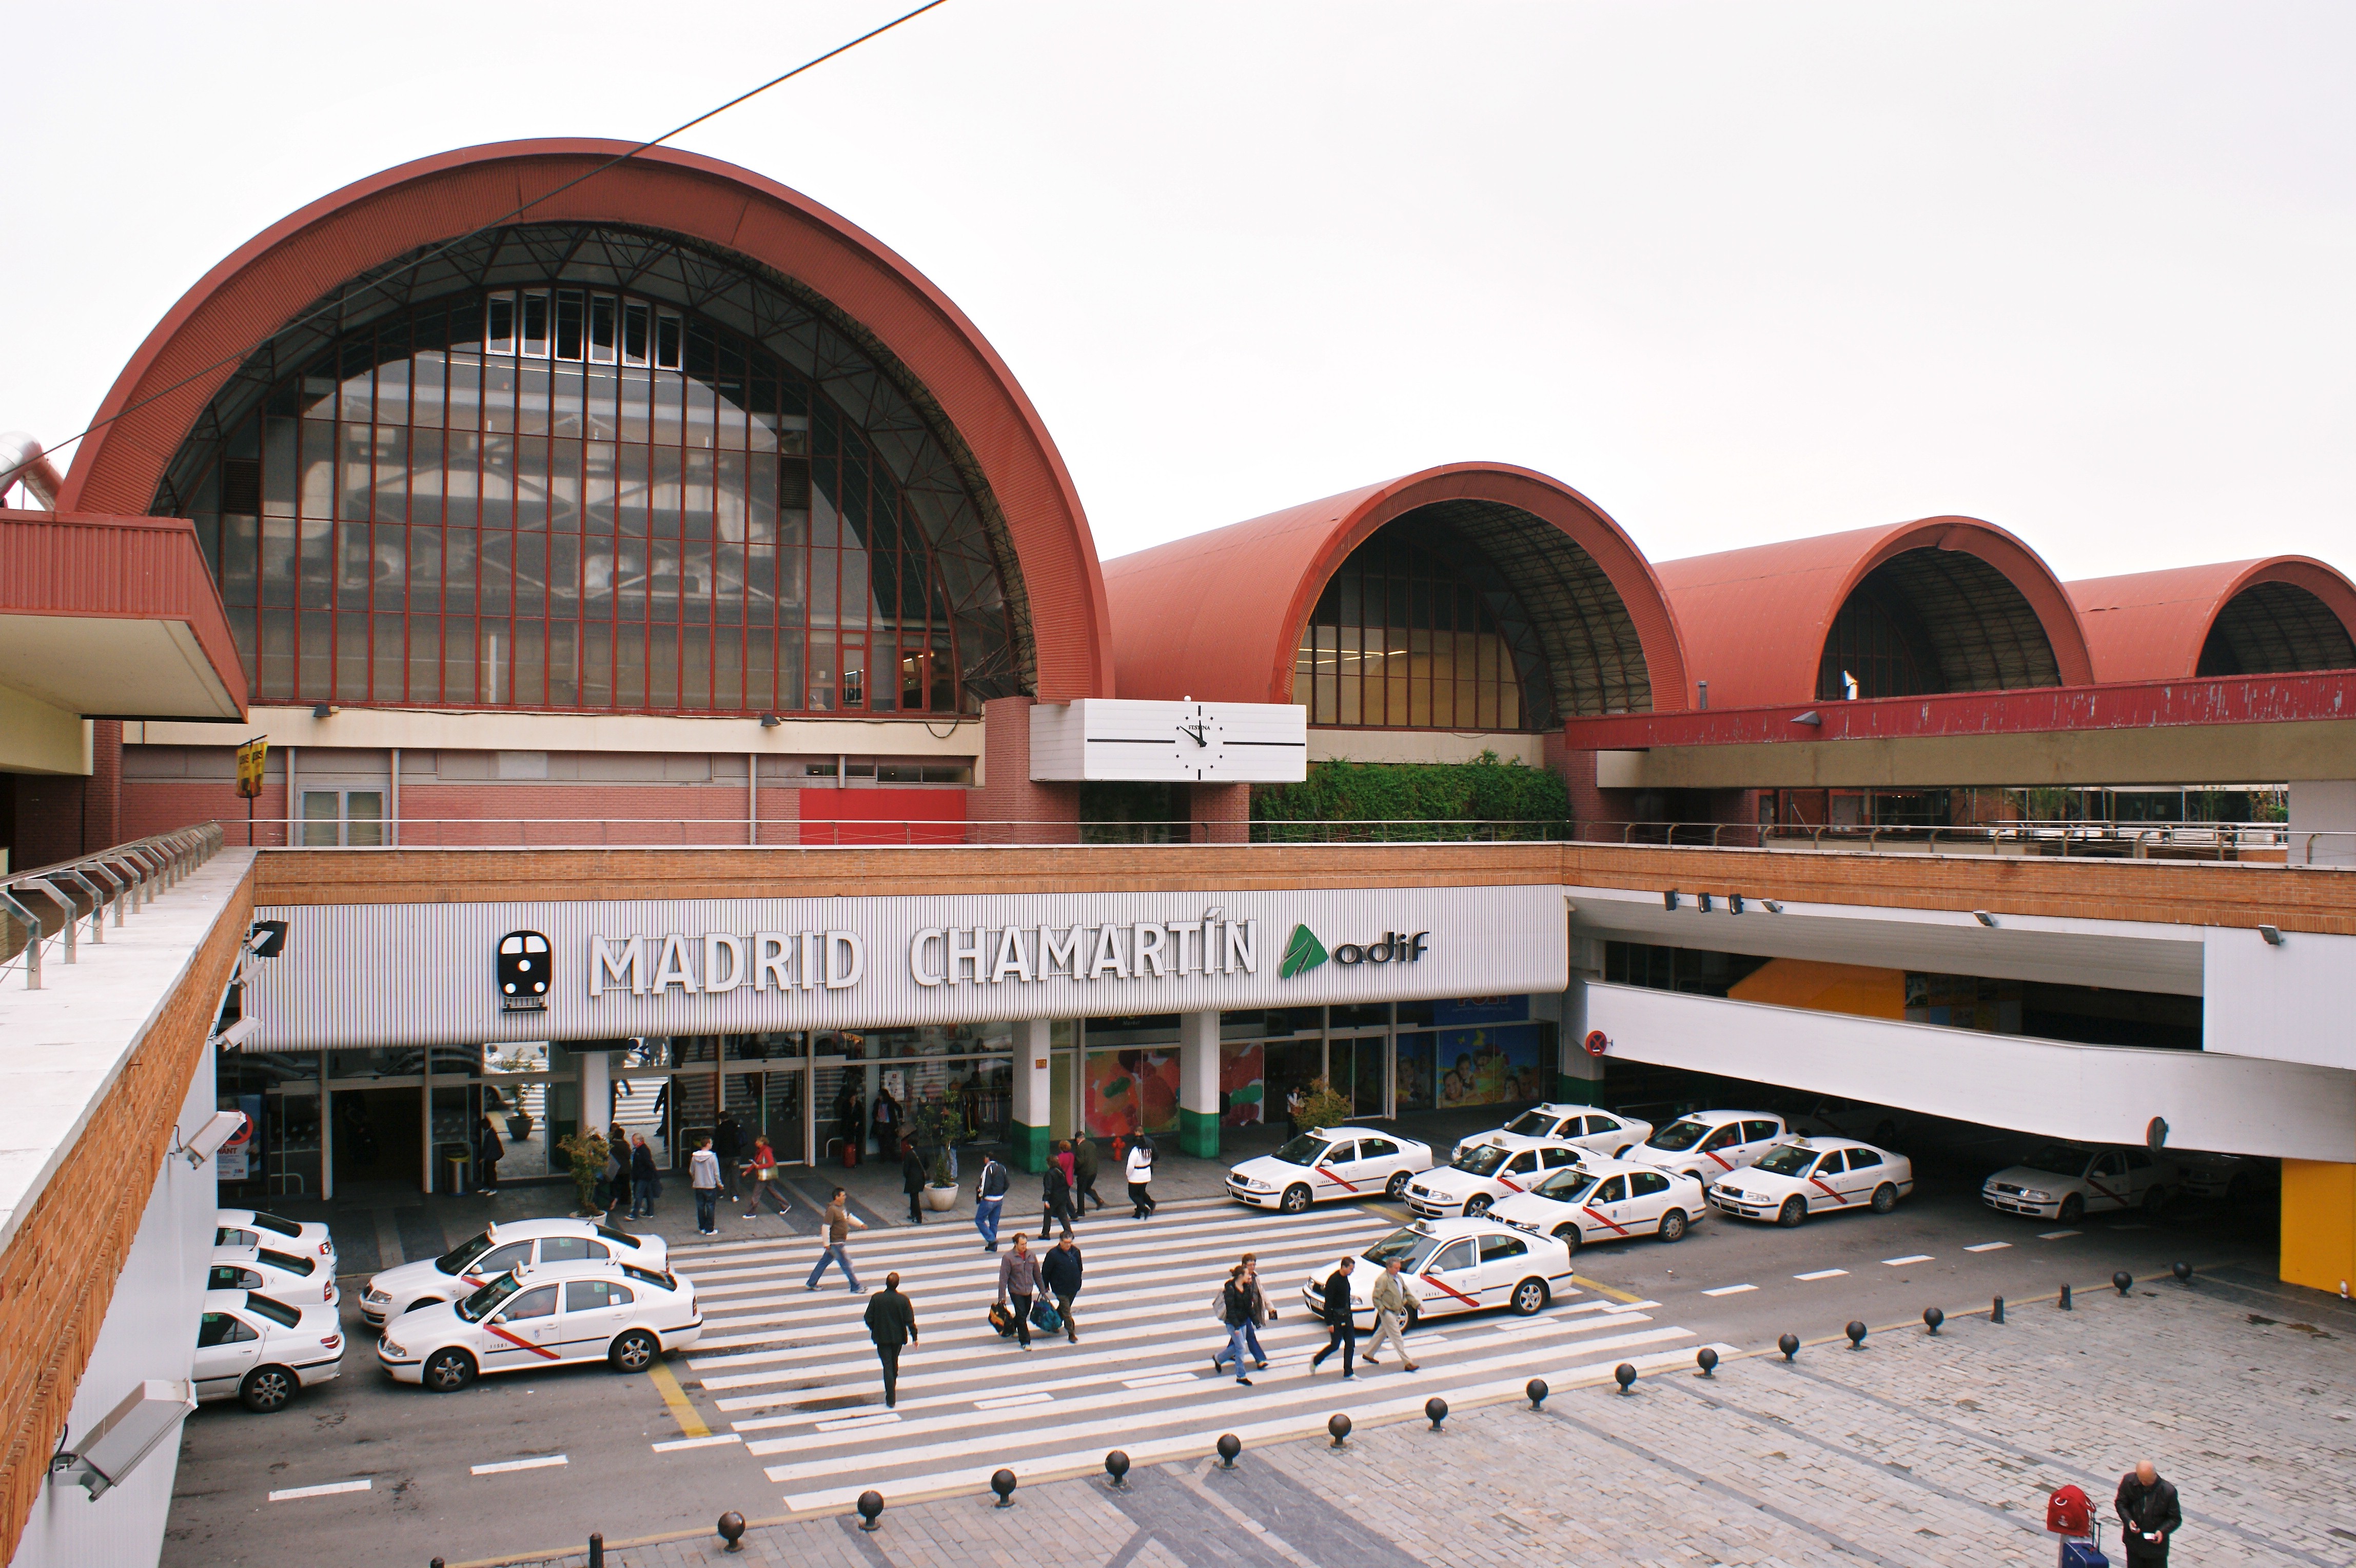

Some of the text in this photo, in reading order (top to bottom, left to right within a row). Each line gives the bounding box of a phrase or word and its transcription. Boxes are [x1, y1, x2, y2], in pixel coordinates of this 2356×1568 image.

[590, 906, 1257, 996] MADRID CHAMARTÍN
[1331, 931, 1429, 965] adif
